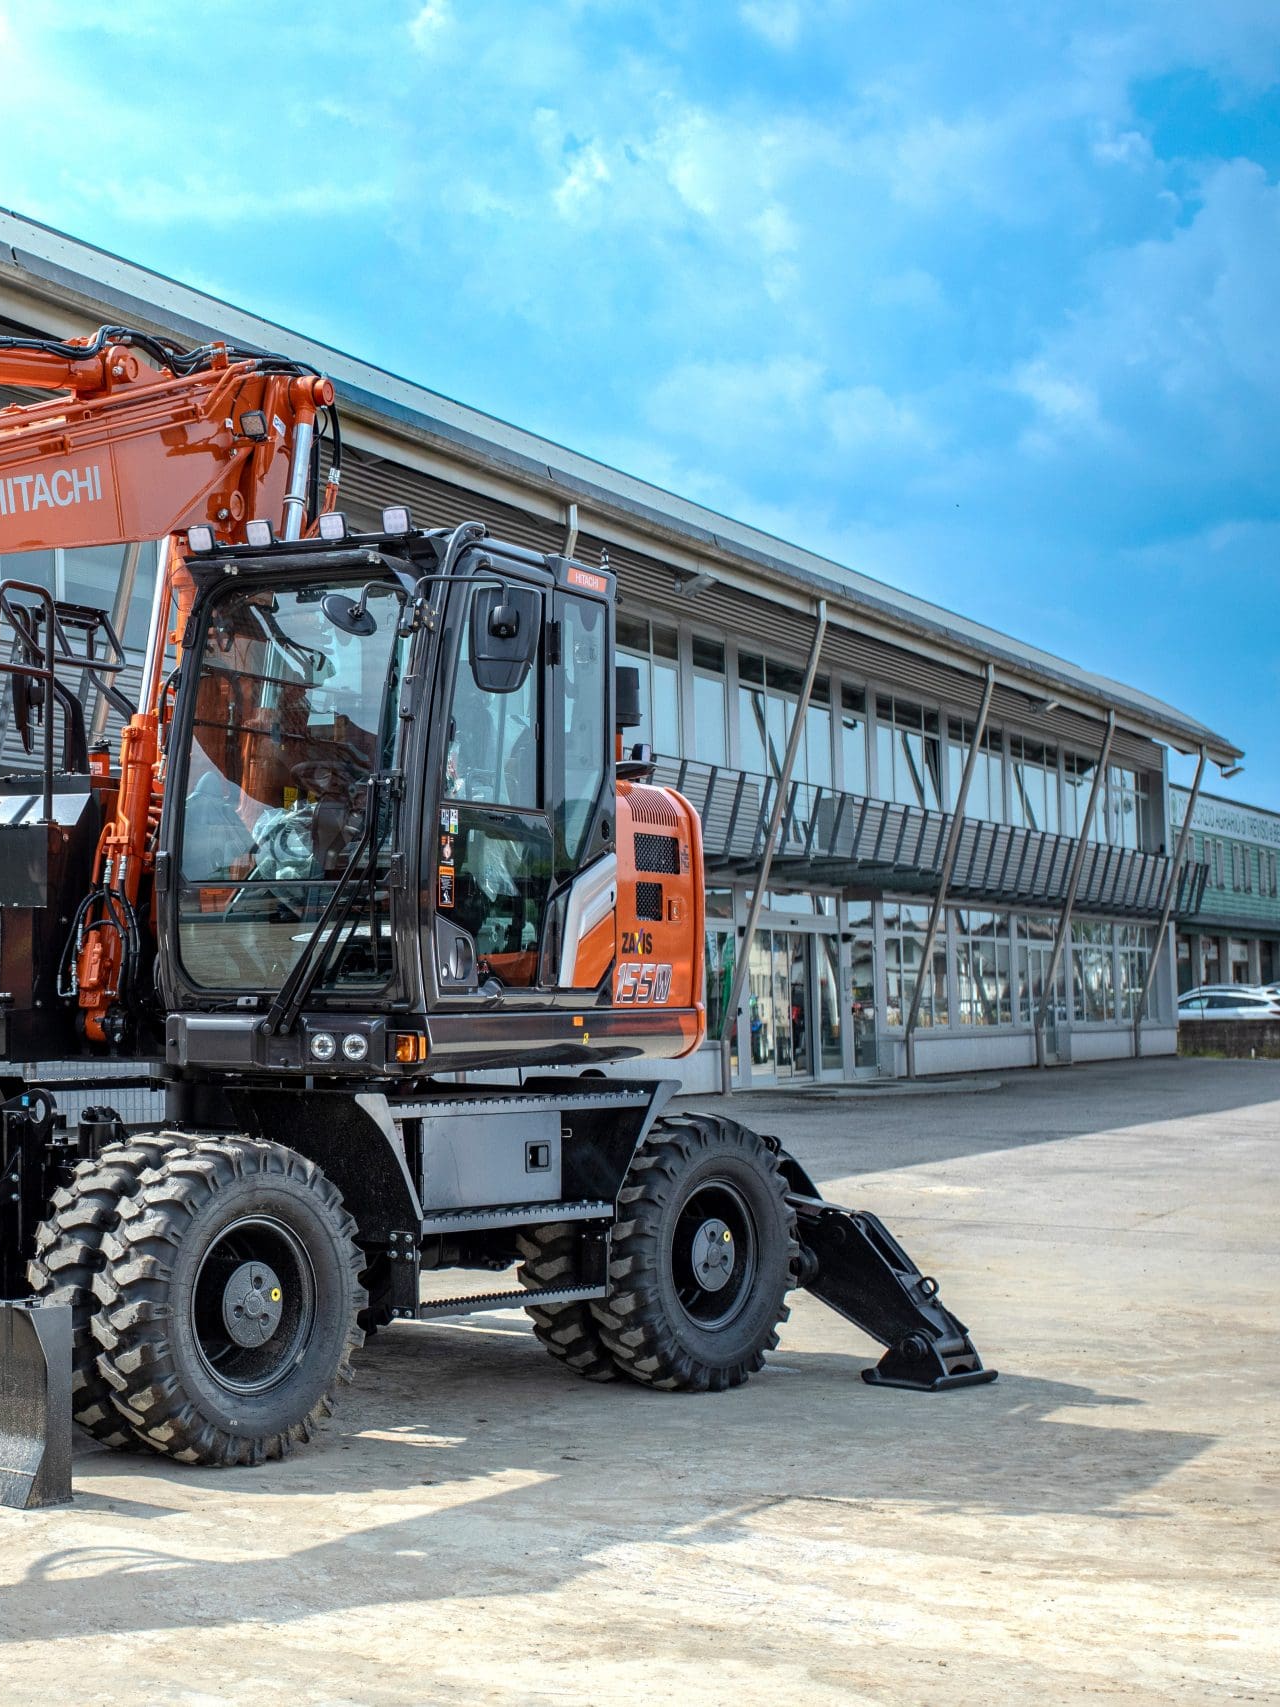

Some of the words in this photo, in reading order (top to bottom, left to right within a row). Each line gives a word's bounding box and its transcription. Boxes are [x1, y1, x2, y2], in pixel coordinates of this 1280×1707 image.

[575, 571, 599, 589] HITACHI
[621, 928, 653, 955] ZAXIS
[614, 962, 673, 1004] 155W
